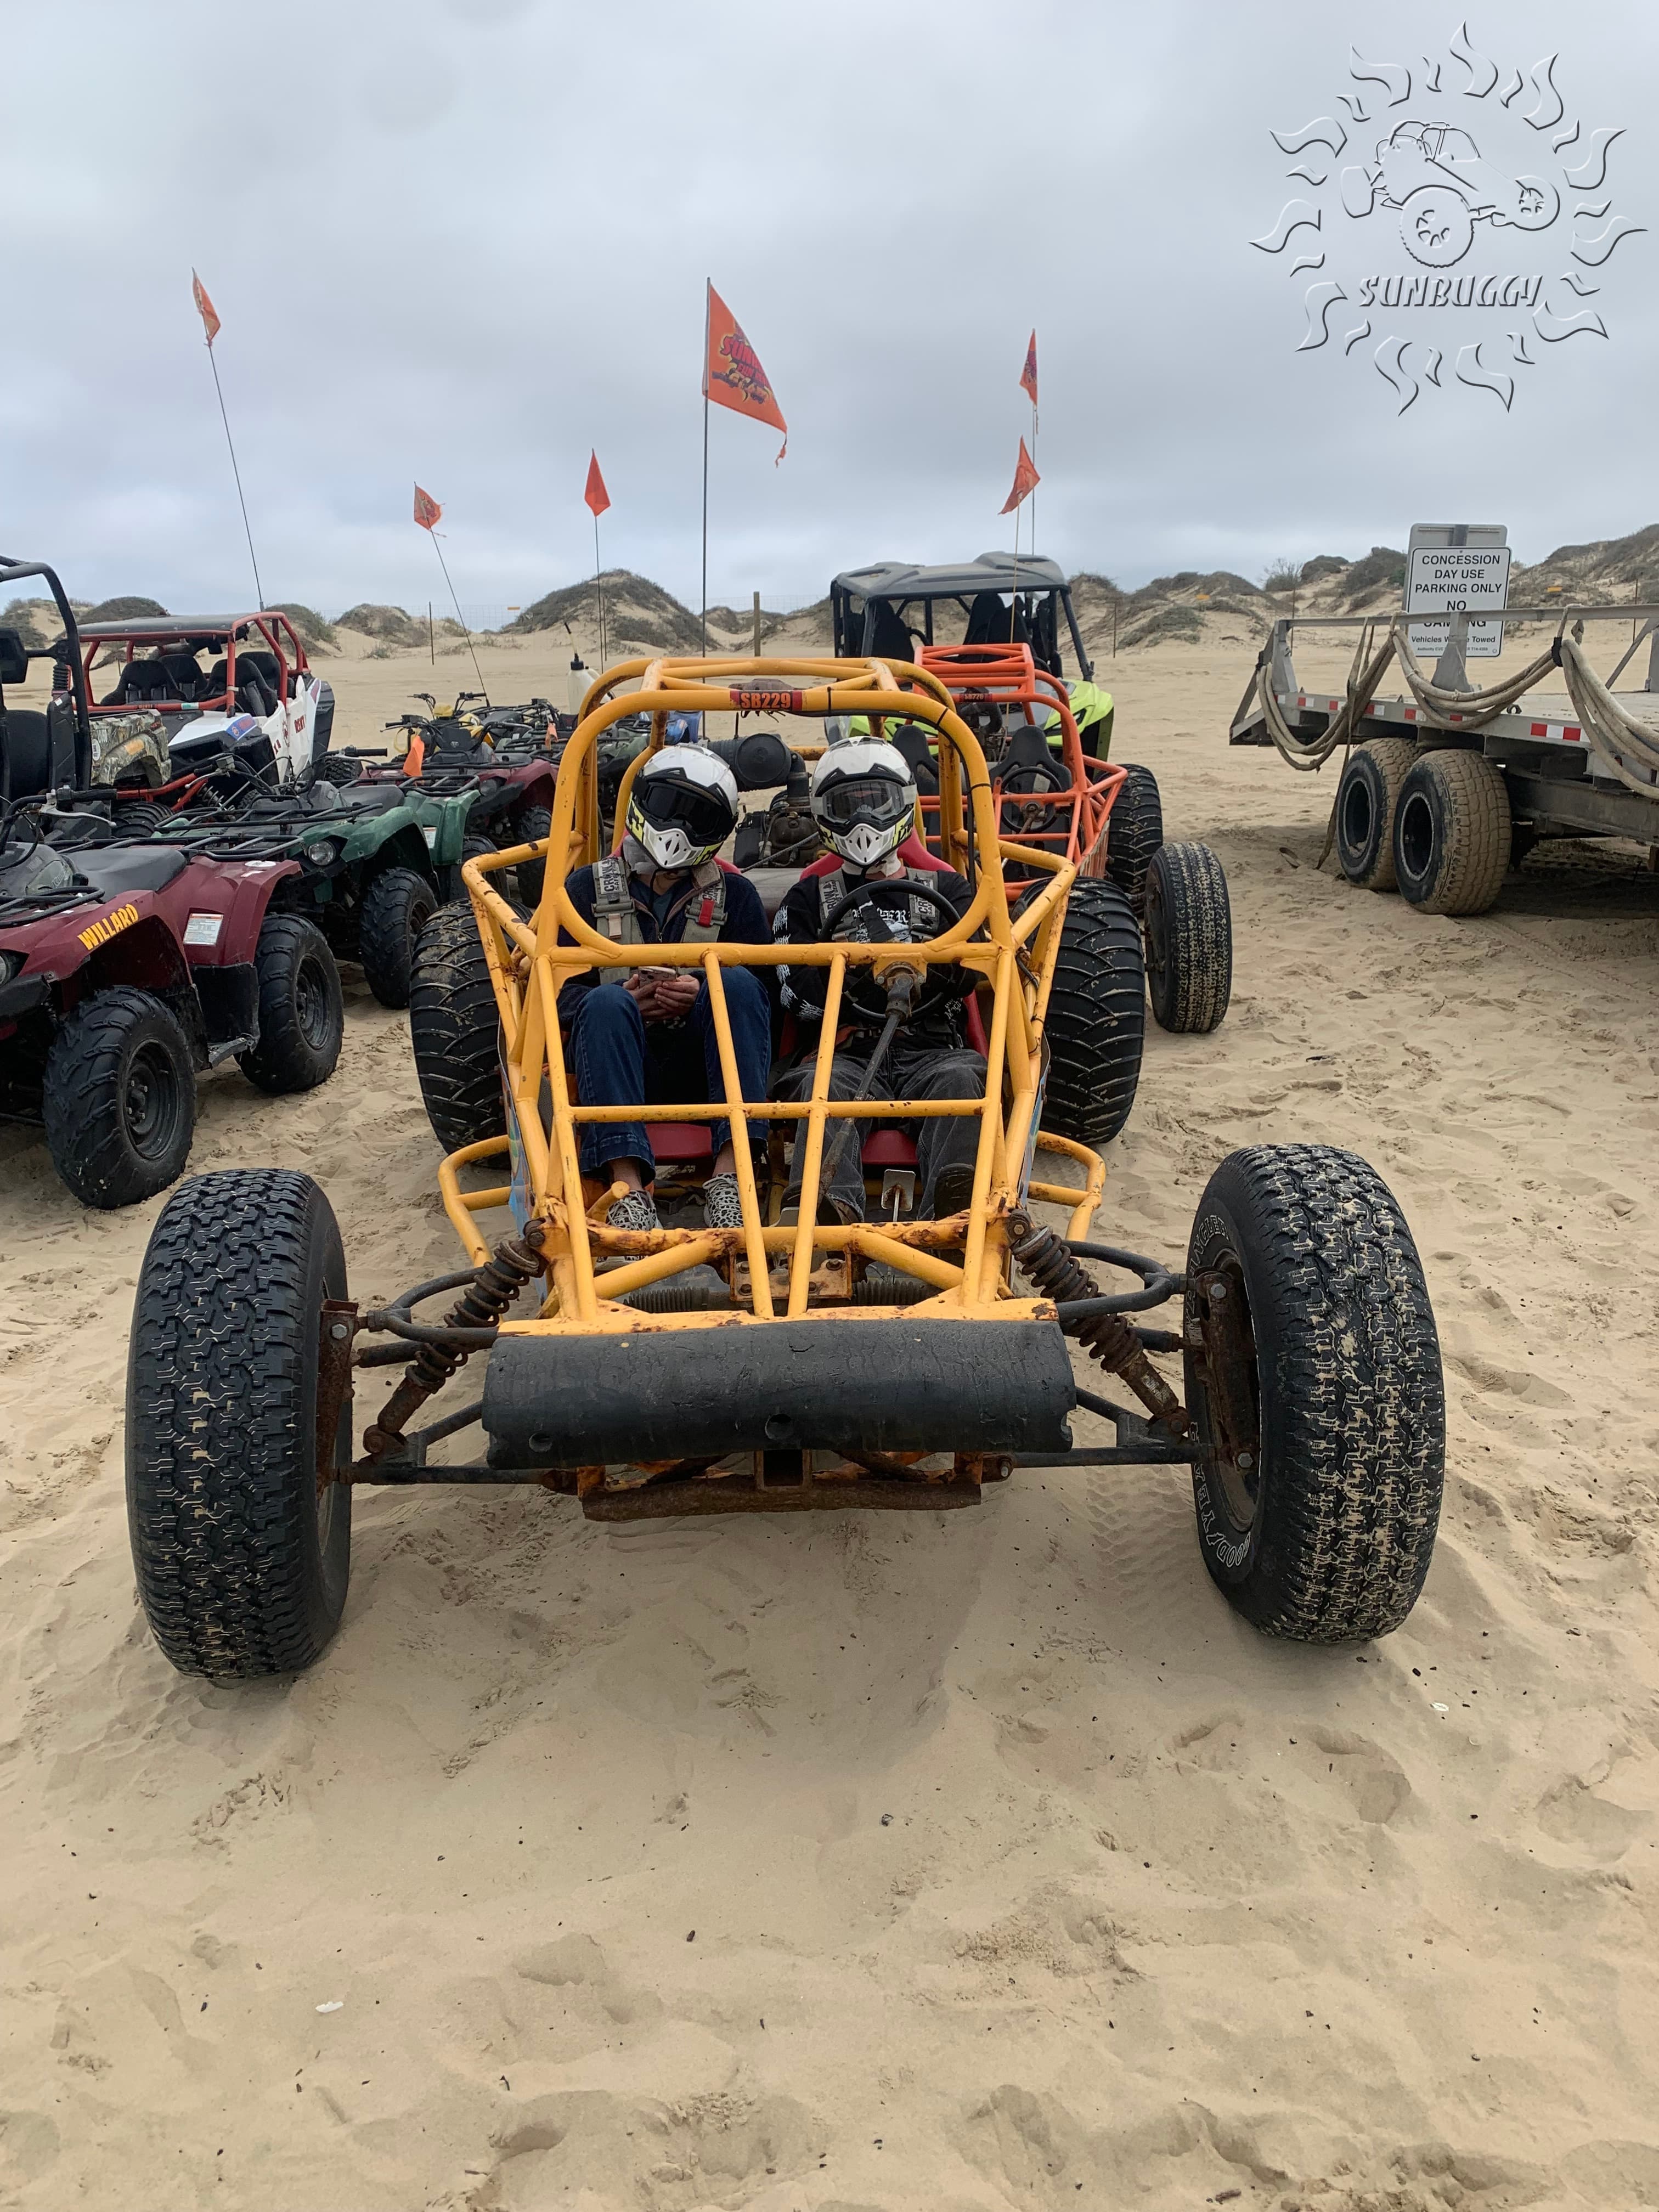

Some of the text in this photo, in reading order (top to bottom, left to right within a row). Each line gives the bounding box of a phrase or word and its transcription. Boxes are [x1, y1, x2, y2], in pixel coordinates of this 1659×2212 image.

[1422, 555, 1500, 565] CONCESSION
[1435, 569, 1485, 579] DAY USE
[1415, 583, 1502, 593] PARKING ONLY
[1447, 601, 1466, 611] NO
[741, 692, 791, 709] SB229
[77, 904, 139, 950] WILLARD
